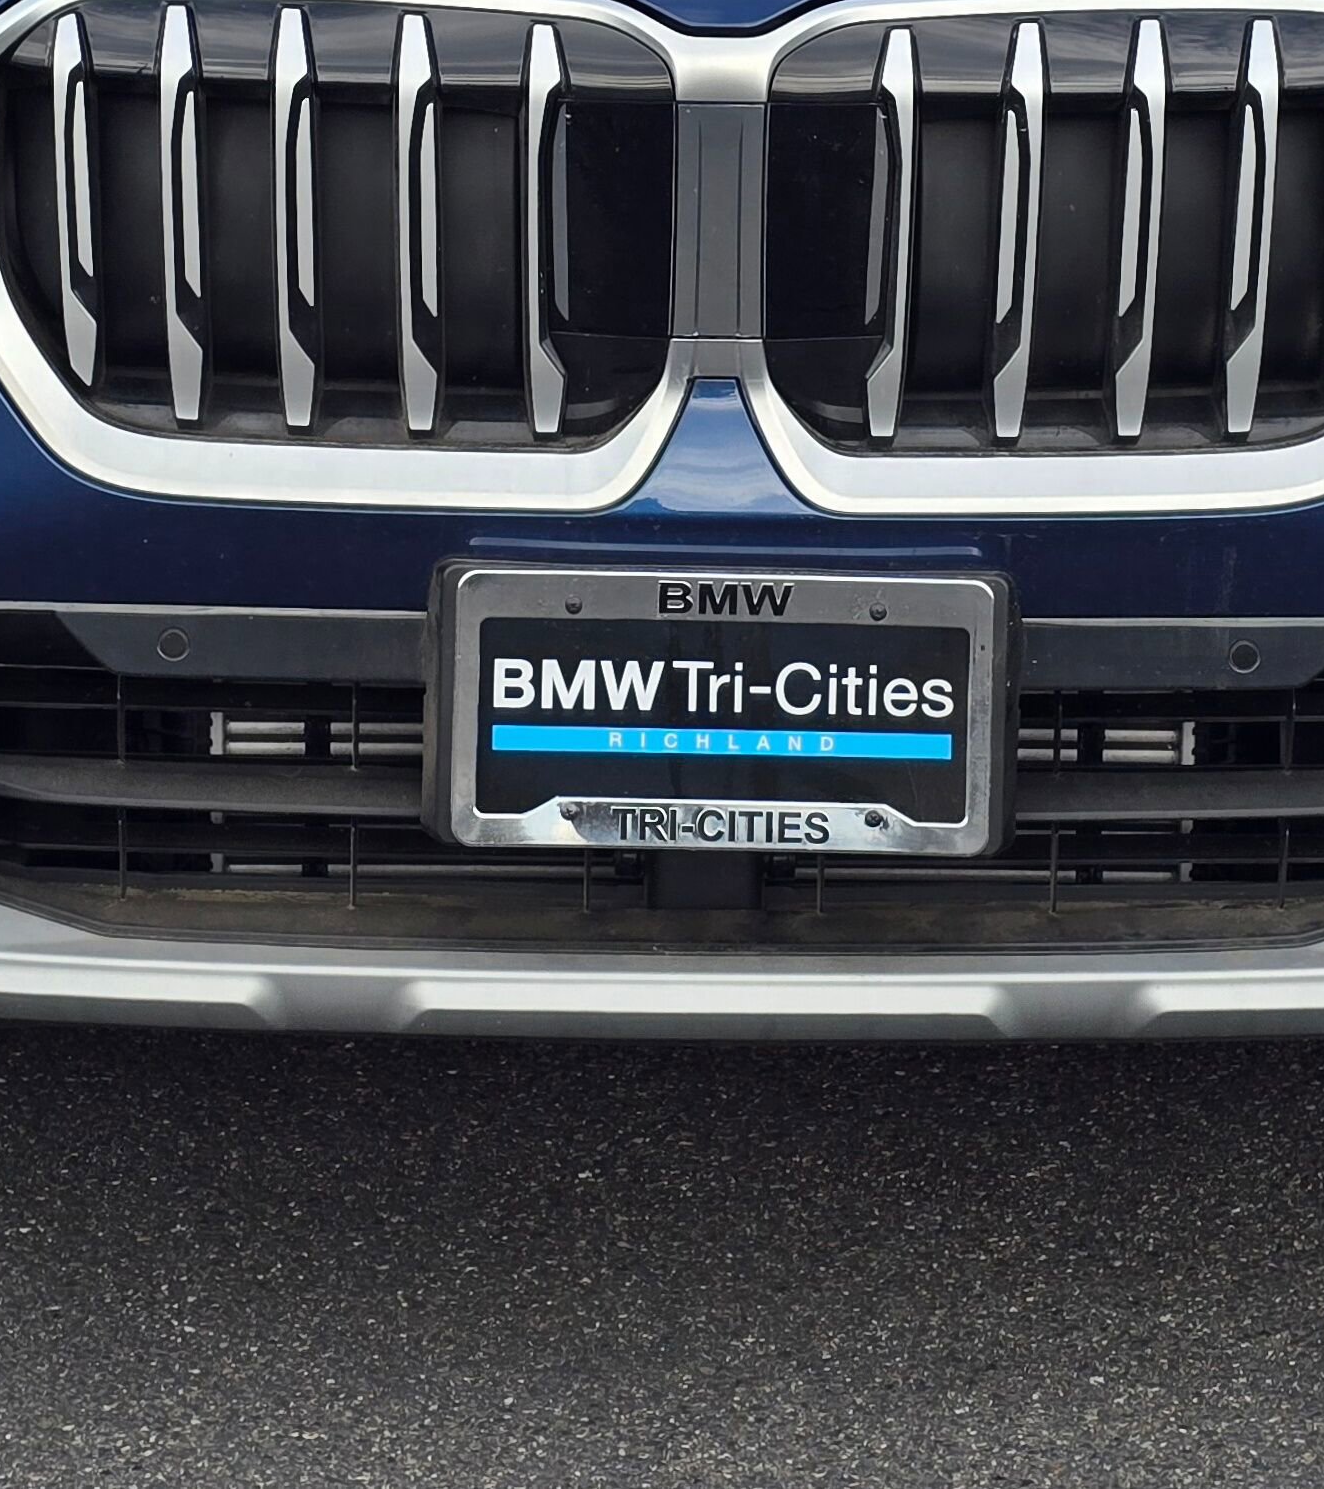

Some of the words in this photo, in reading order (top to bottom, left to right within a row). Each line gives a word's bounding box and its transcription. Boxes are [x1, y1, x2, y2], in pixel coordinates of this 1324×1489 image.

[658, 581, 794, 617] BMW
[492, 657, 665, 710] BMW
[672, 659, 956, 718] Tri-Cities
[609, 731, 838, 753] RICHLAND
[611, 806, 831, 846] TRI-CITIES
